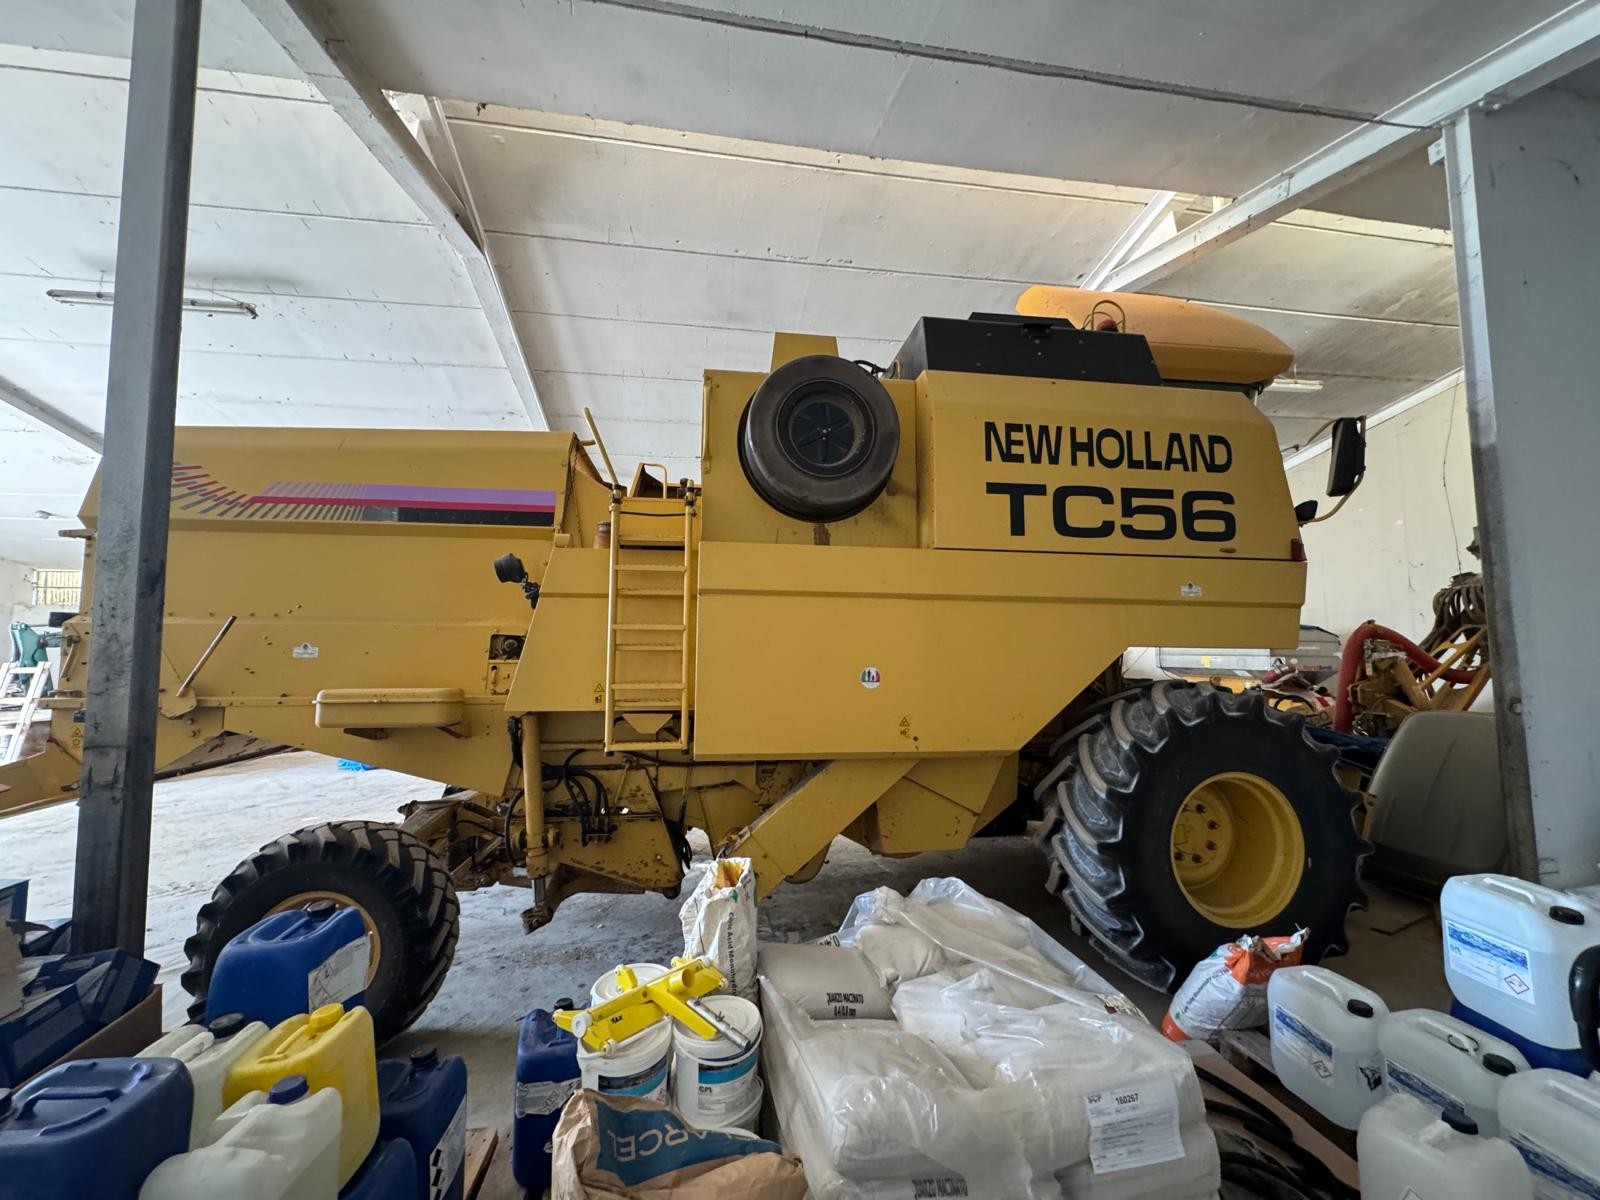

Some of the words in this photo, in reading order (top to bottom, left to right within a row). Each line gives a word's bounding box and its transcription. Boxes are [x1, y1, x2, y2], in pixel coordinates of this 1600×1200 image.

[984, 421, 1063, 466] NEW
[1069, 427, 1233, 474] HOLLAND
[985, 481, 1237, 543] TC56
